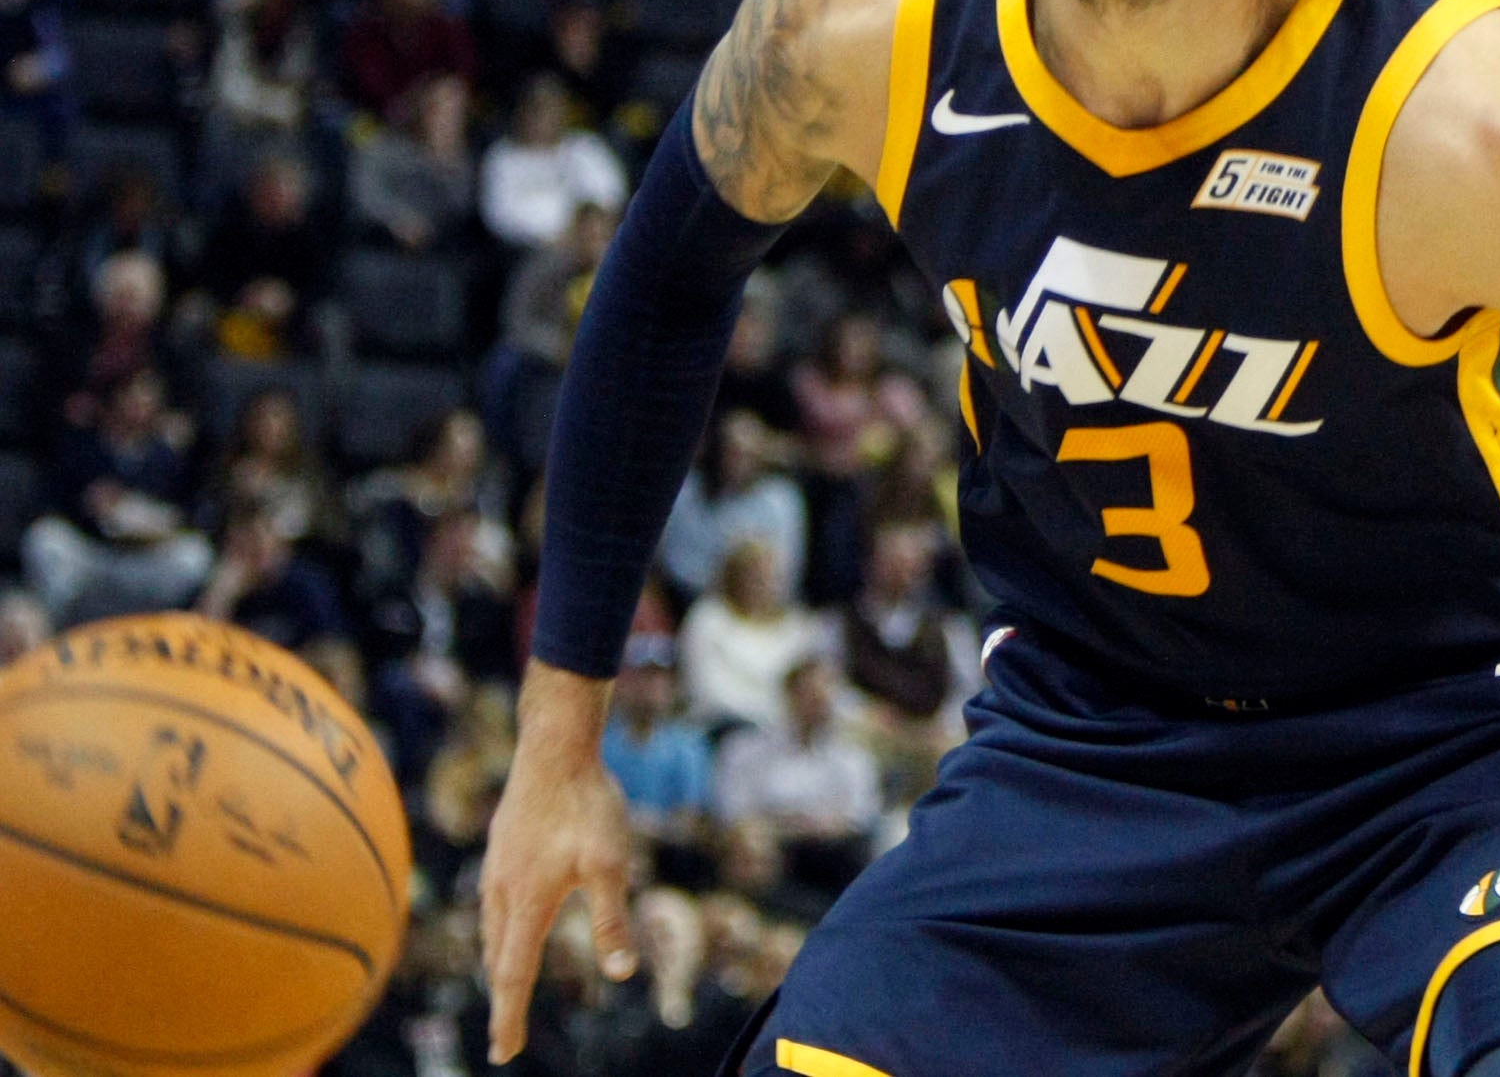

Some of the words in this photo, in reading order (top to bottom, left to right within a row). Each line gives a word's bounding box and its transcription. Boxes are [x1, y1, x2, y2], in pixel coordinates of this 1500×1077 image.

[1210, 159, 1247, 199] 5
[1260, 162, 1283, 177] FOR
[1287, 166, 1307, 180] THE
[1244, 183, 1308, 210] FIGHT
[943, 236, 1324, 437] JAZZ
[1057, 422, 1211, 598] 3
